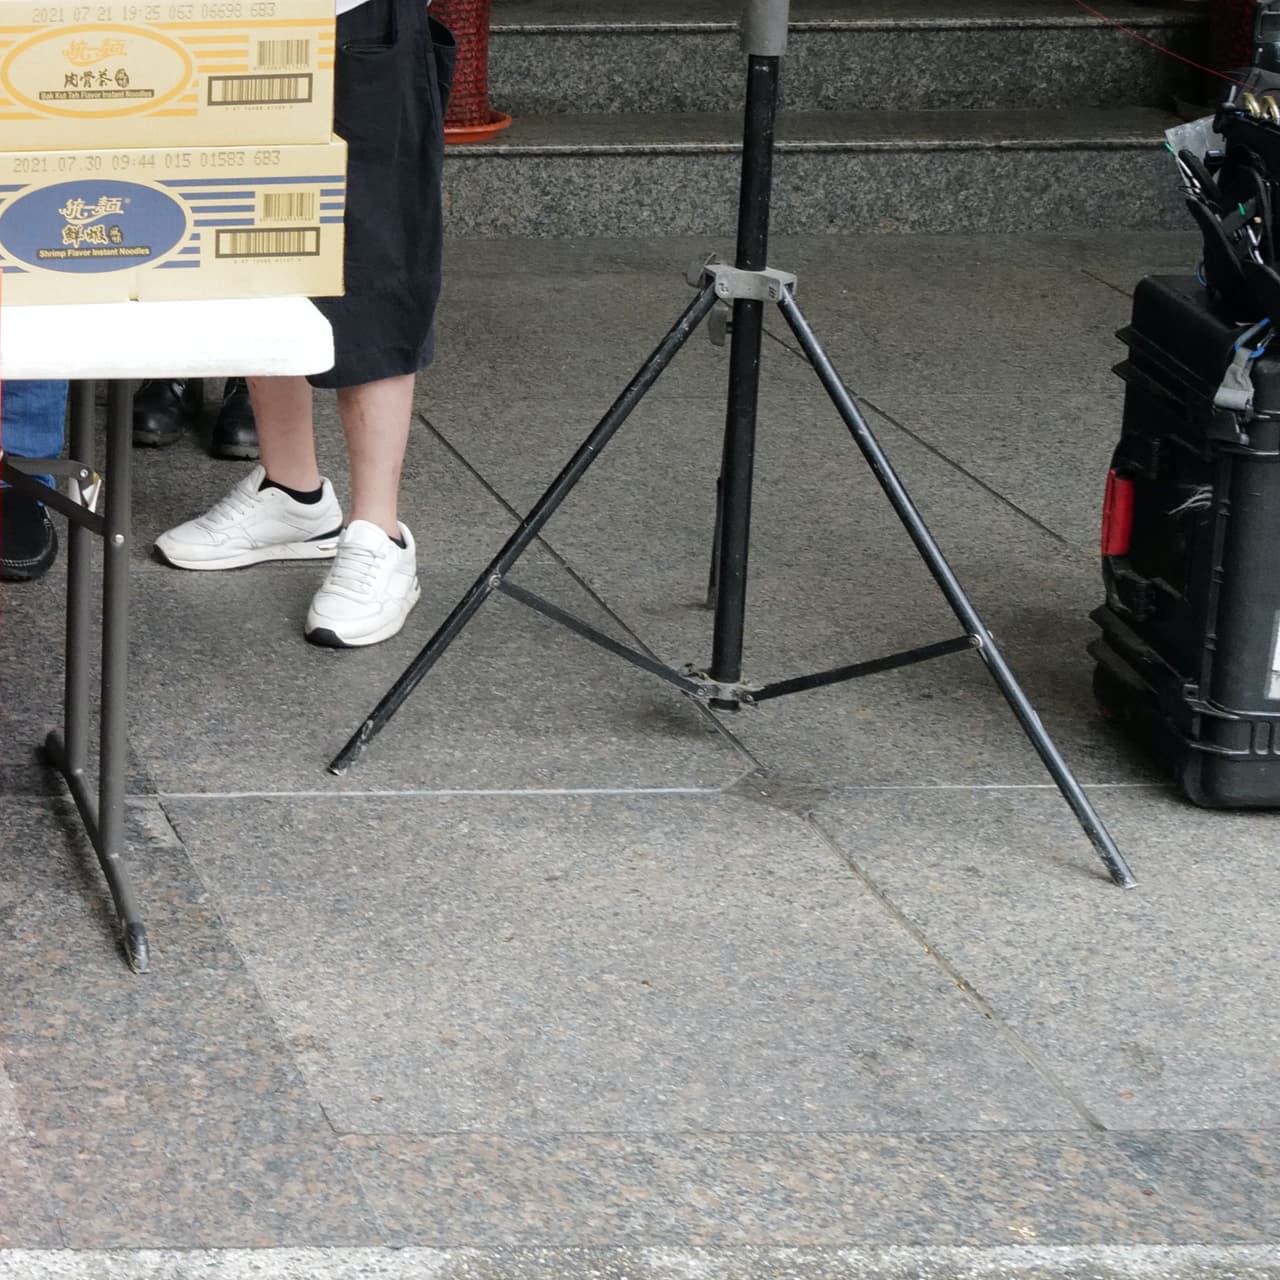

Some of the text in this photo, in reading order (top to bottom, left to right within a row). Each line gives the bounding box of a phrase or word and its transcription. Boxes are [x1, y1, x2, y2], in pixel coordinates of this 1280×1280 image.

[63, 37, 129, 64] 統一麵
[64, 68, 113, 88] 肉骨茶
[58, 196, 124, 222] 統一麵
[61, 223, 109, 247] 鮮蝦
[39, 246, 150, 259] Shrimp Flavor Instant Noodles
